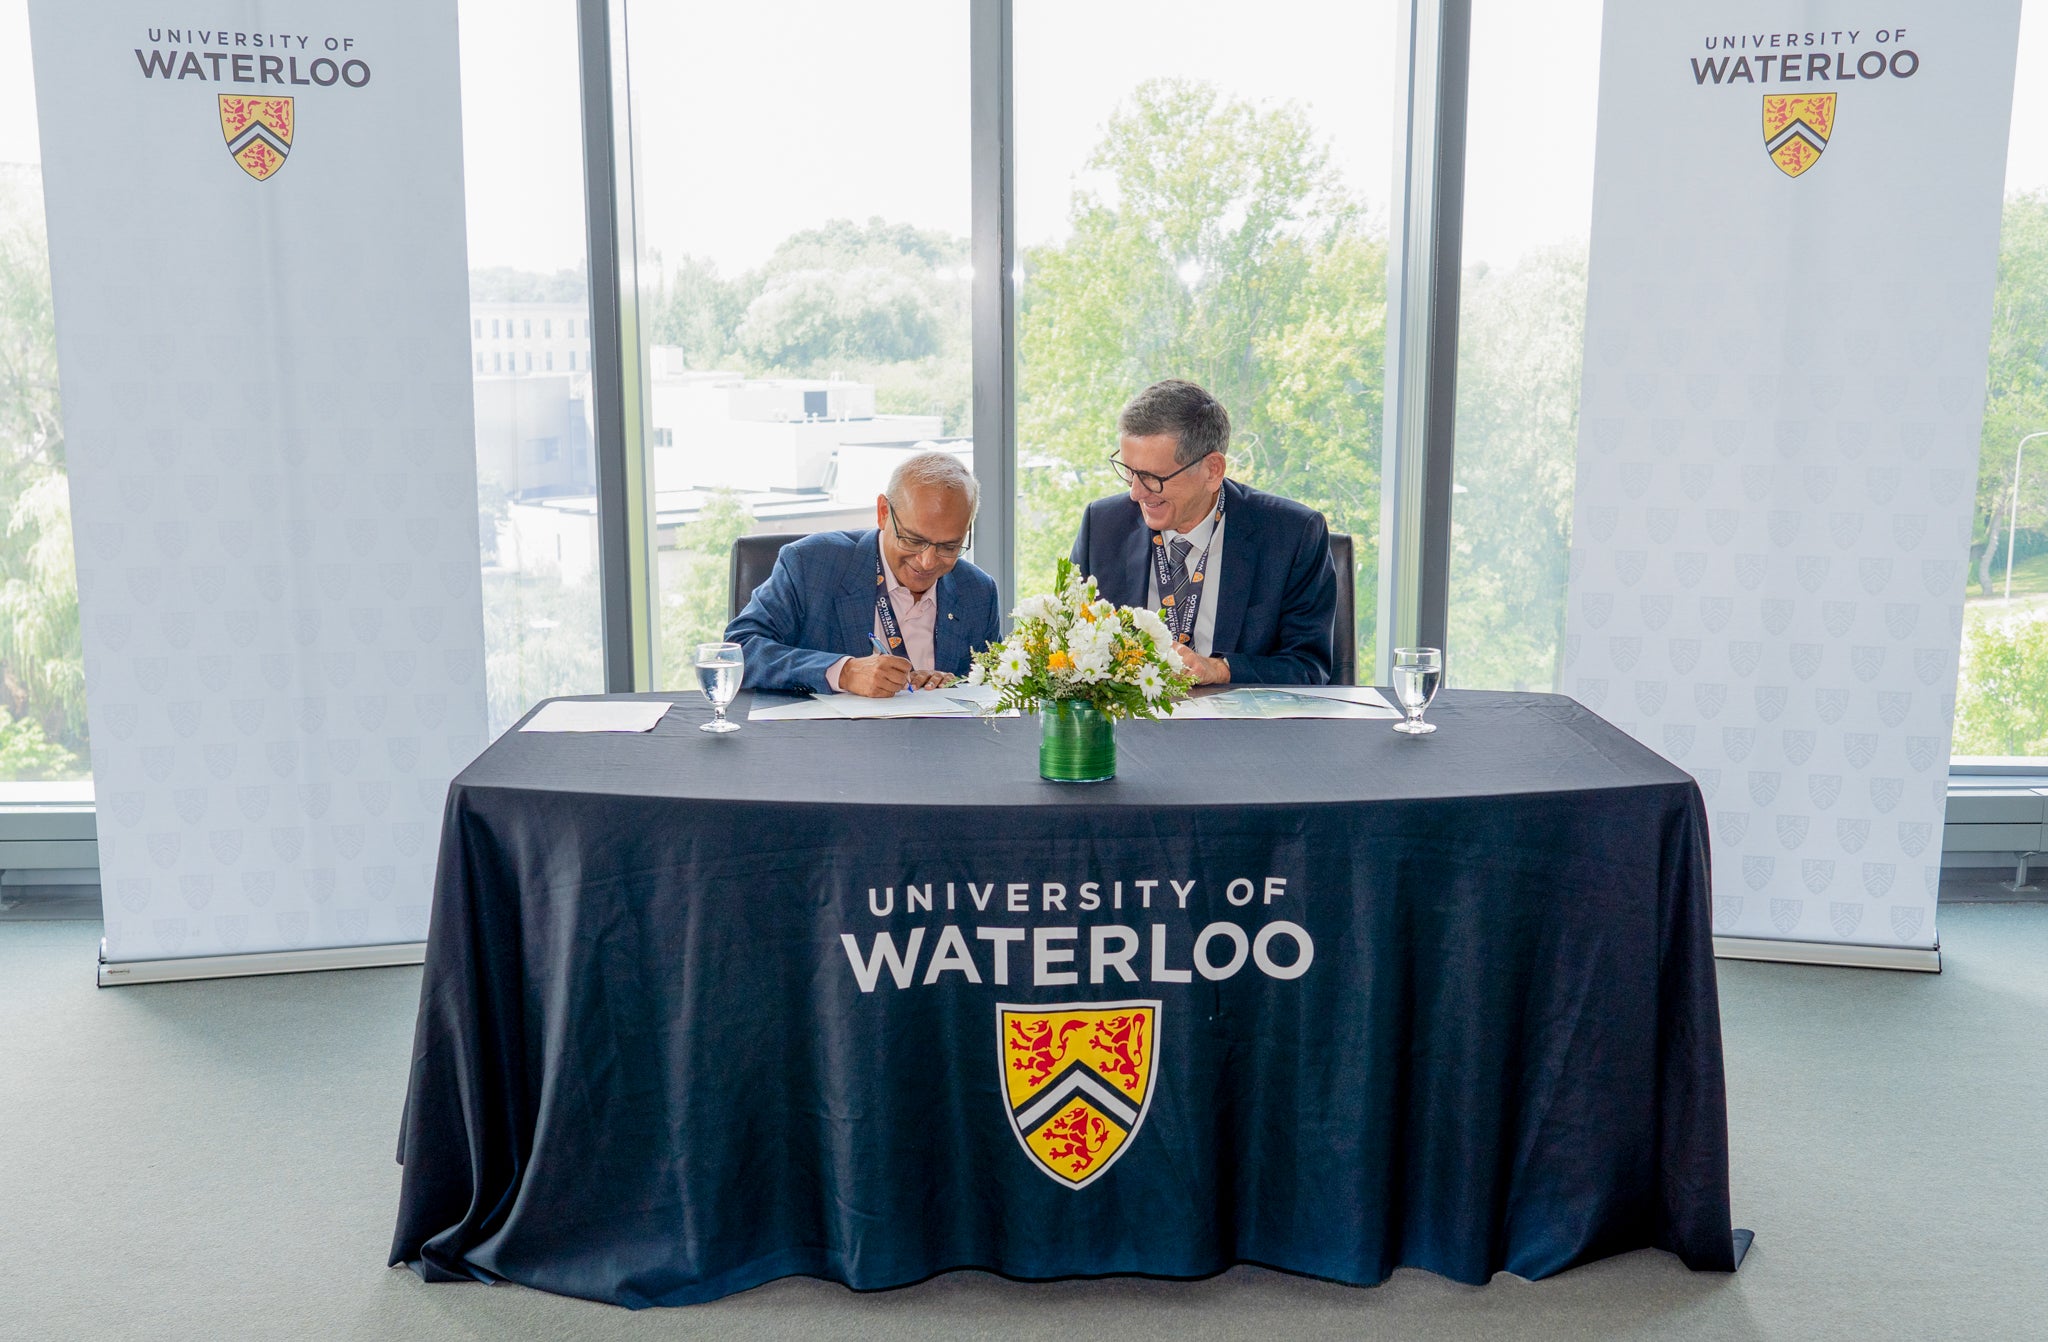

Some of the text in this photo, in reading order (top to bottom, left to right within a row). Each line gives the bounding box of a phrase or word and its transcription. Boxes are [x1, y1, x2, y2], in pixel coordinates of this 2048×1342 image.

[149, 28, 354, 52] UNIVERSITY OF
[1705, 28, 1906, 50] UNIVERSITY OF
[134, 49, 371, 88] WATERLOO
[1690, 50, 1920, 85] WATERLOO
[1156, 546, 1167, 584] WATERLOO
[880, 597, 896, 636] WATERLOO
[1167, 606, 1178, 641] WATERLO
[1184, 594, 1197, 633] WATERLOO
[868, 877, 1287, 917] UNIVERSITY OF
[840, 920, 1314, 993] WATERLOO
